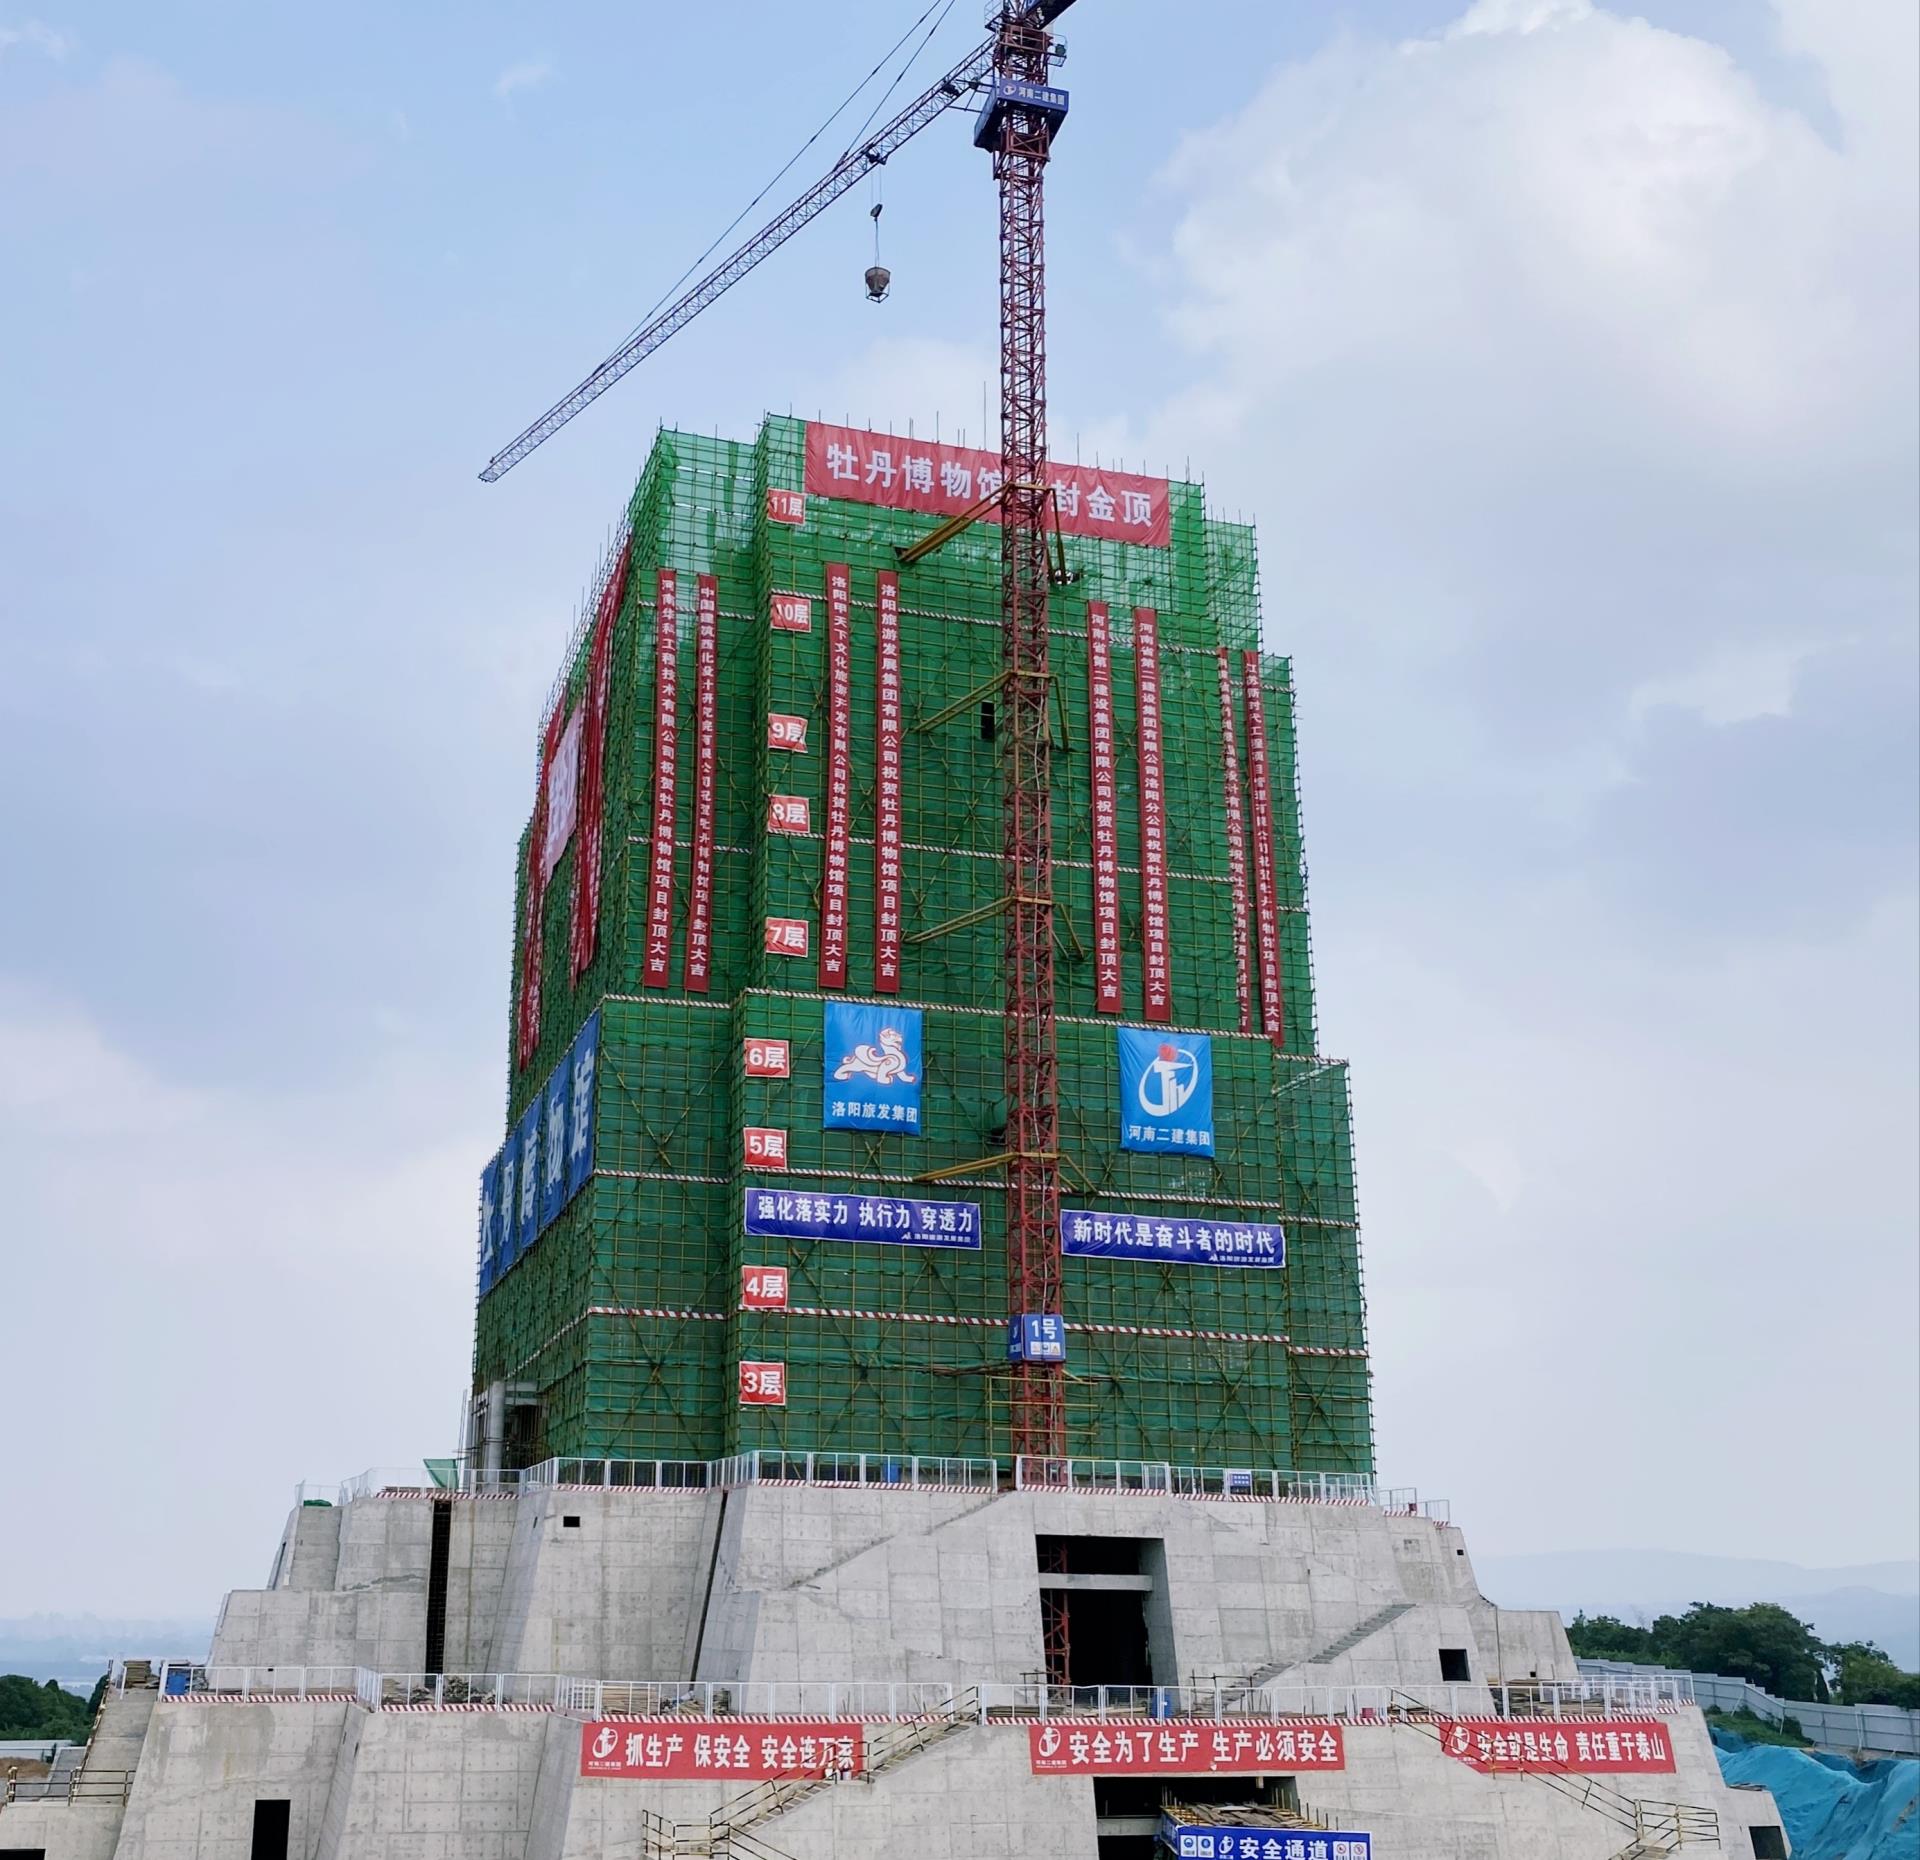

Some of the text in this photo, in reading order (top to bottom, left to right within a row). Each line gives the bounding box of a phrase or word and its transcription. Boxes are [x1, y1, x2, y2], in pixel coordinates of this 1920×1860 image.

[827, 442, 1152, 528] 牡丹博物馆封金顶
[771, 494, 803, 520] 11层
[777, 603, 809, 625] 10层
[772, 721, 804, 743] 9层
[880, 584, 899, 977] 洛阳旅游发展集团有限公司祝贺牡丹博物馆项目封顶大吉
[771, 803, 807, 825] 8层
[1091, 614, 1117, 998] 河南省第二建设集团有限公司祝贺牡丹博物馆项目封顶大吉
[1139, 623, 1165, 1006] 河南省第二建设集团有限公司洛阳分公司祝贺牡丹博物馆项目封顶大吉
[769, 926, 805, 948] 7层
[749, 1046, 786, 1070] 6层
[832, 1101, 917, 1123] 洛阳旅发集团
[748, 1135, 784, 1159] 5层
[1128, 1125, 1210, 1146] 河南二建集团
[758, 1195, 972, 1233] 强化落实力 执行力 穿透力
[1073, 1217, 1275, 1254] 新时代是奋斗者的时代
[745, 1274, 783, 1299] 4层
[1031, 1318, 1057, 1340] 1号
[744, 1370, 781, 1397] 3层
[625, 1732, 855, 1770] 抓生产 保安全 安全连万家
[1069, 1729, 1338, 1765] 安全为了生产 生产必须安全
[1477, 1730, 1666, 1763] 安全就是生命 责任重于泰山
[1238, 1836, 1329, 1860] 安全通道
